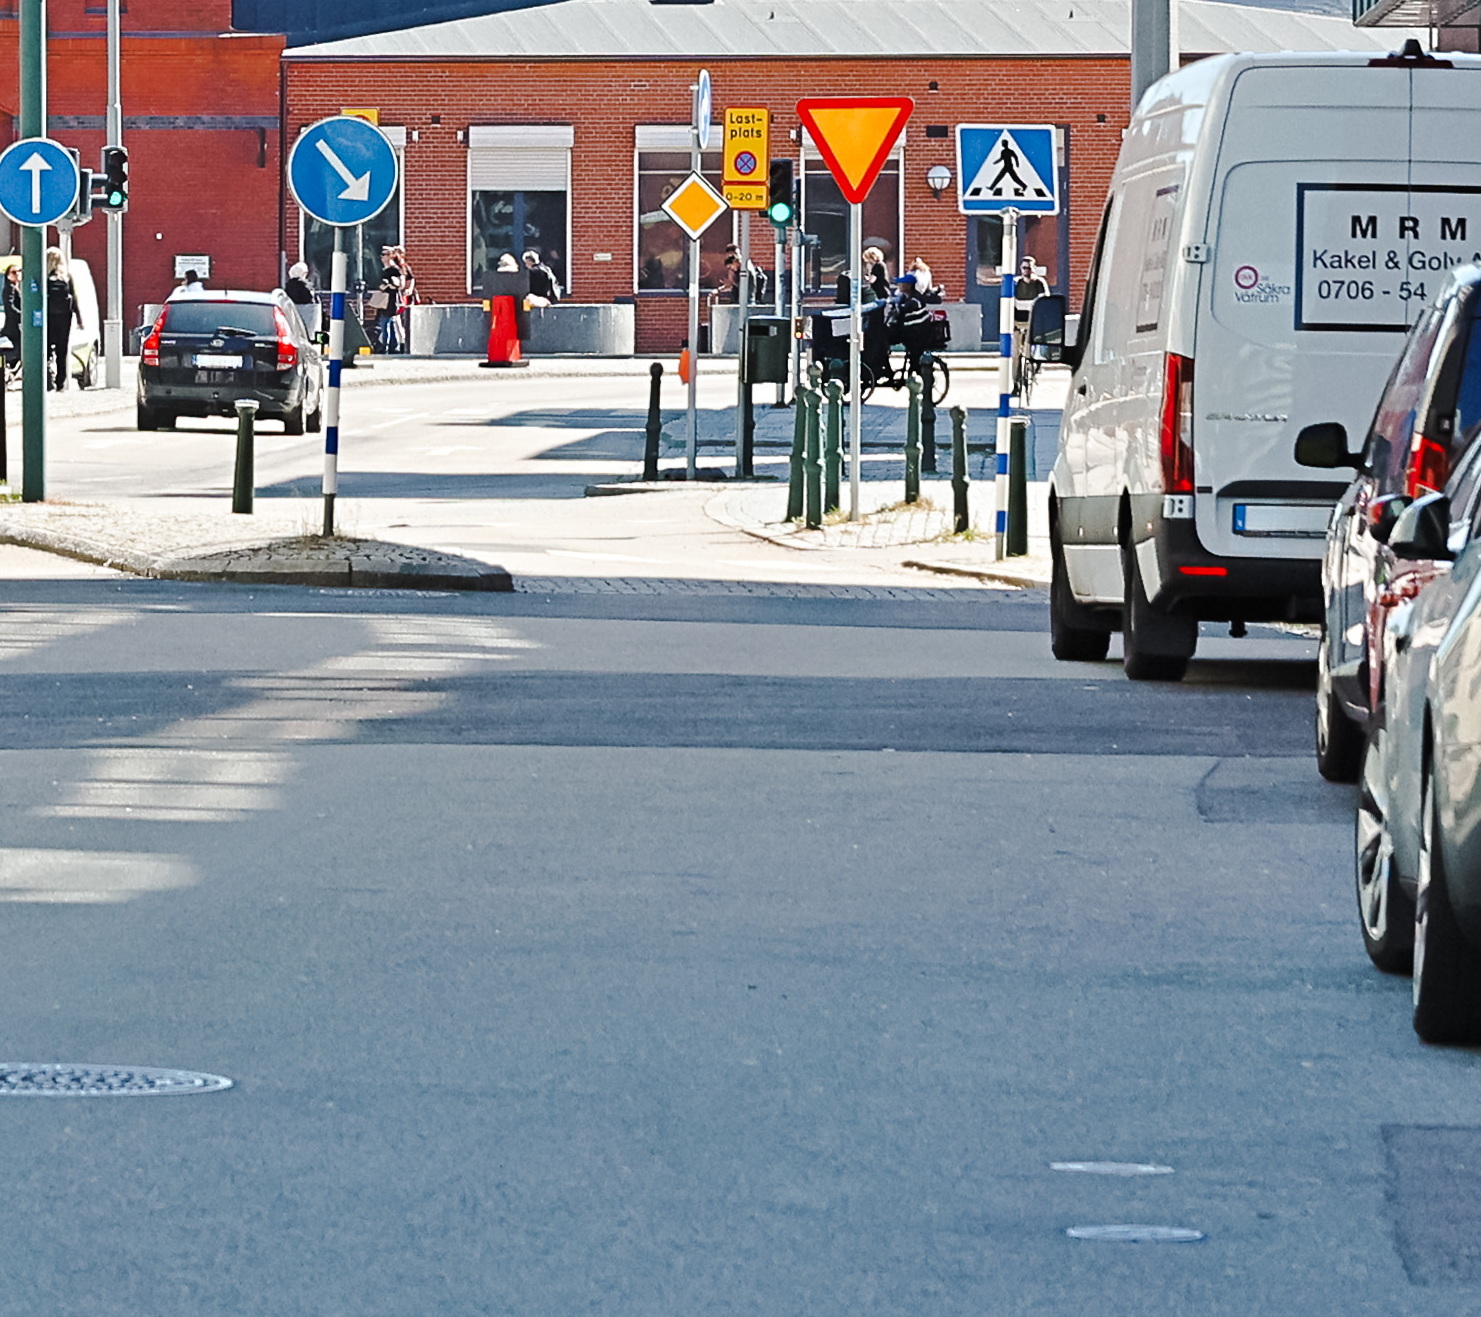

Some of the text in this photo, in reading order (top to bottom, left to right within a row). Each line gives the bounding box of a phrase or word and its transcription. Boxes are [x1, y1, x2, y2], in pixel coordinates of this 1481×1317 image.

[729, 112, 763, 124] Last-
[730, 127, 762, 140] plats
[1313, 249, 1376, 269] Kakel
[1385, 250, 1401, 270] &
[1318, 279, 1374, 300] 0706
[1398, 282, 1427, 301] 54
